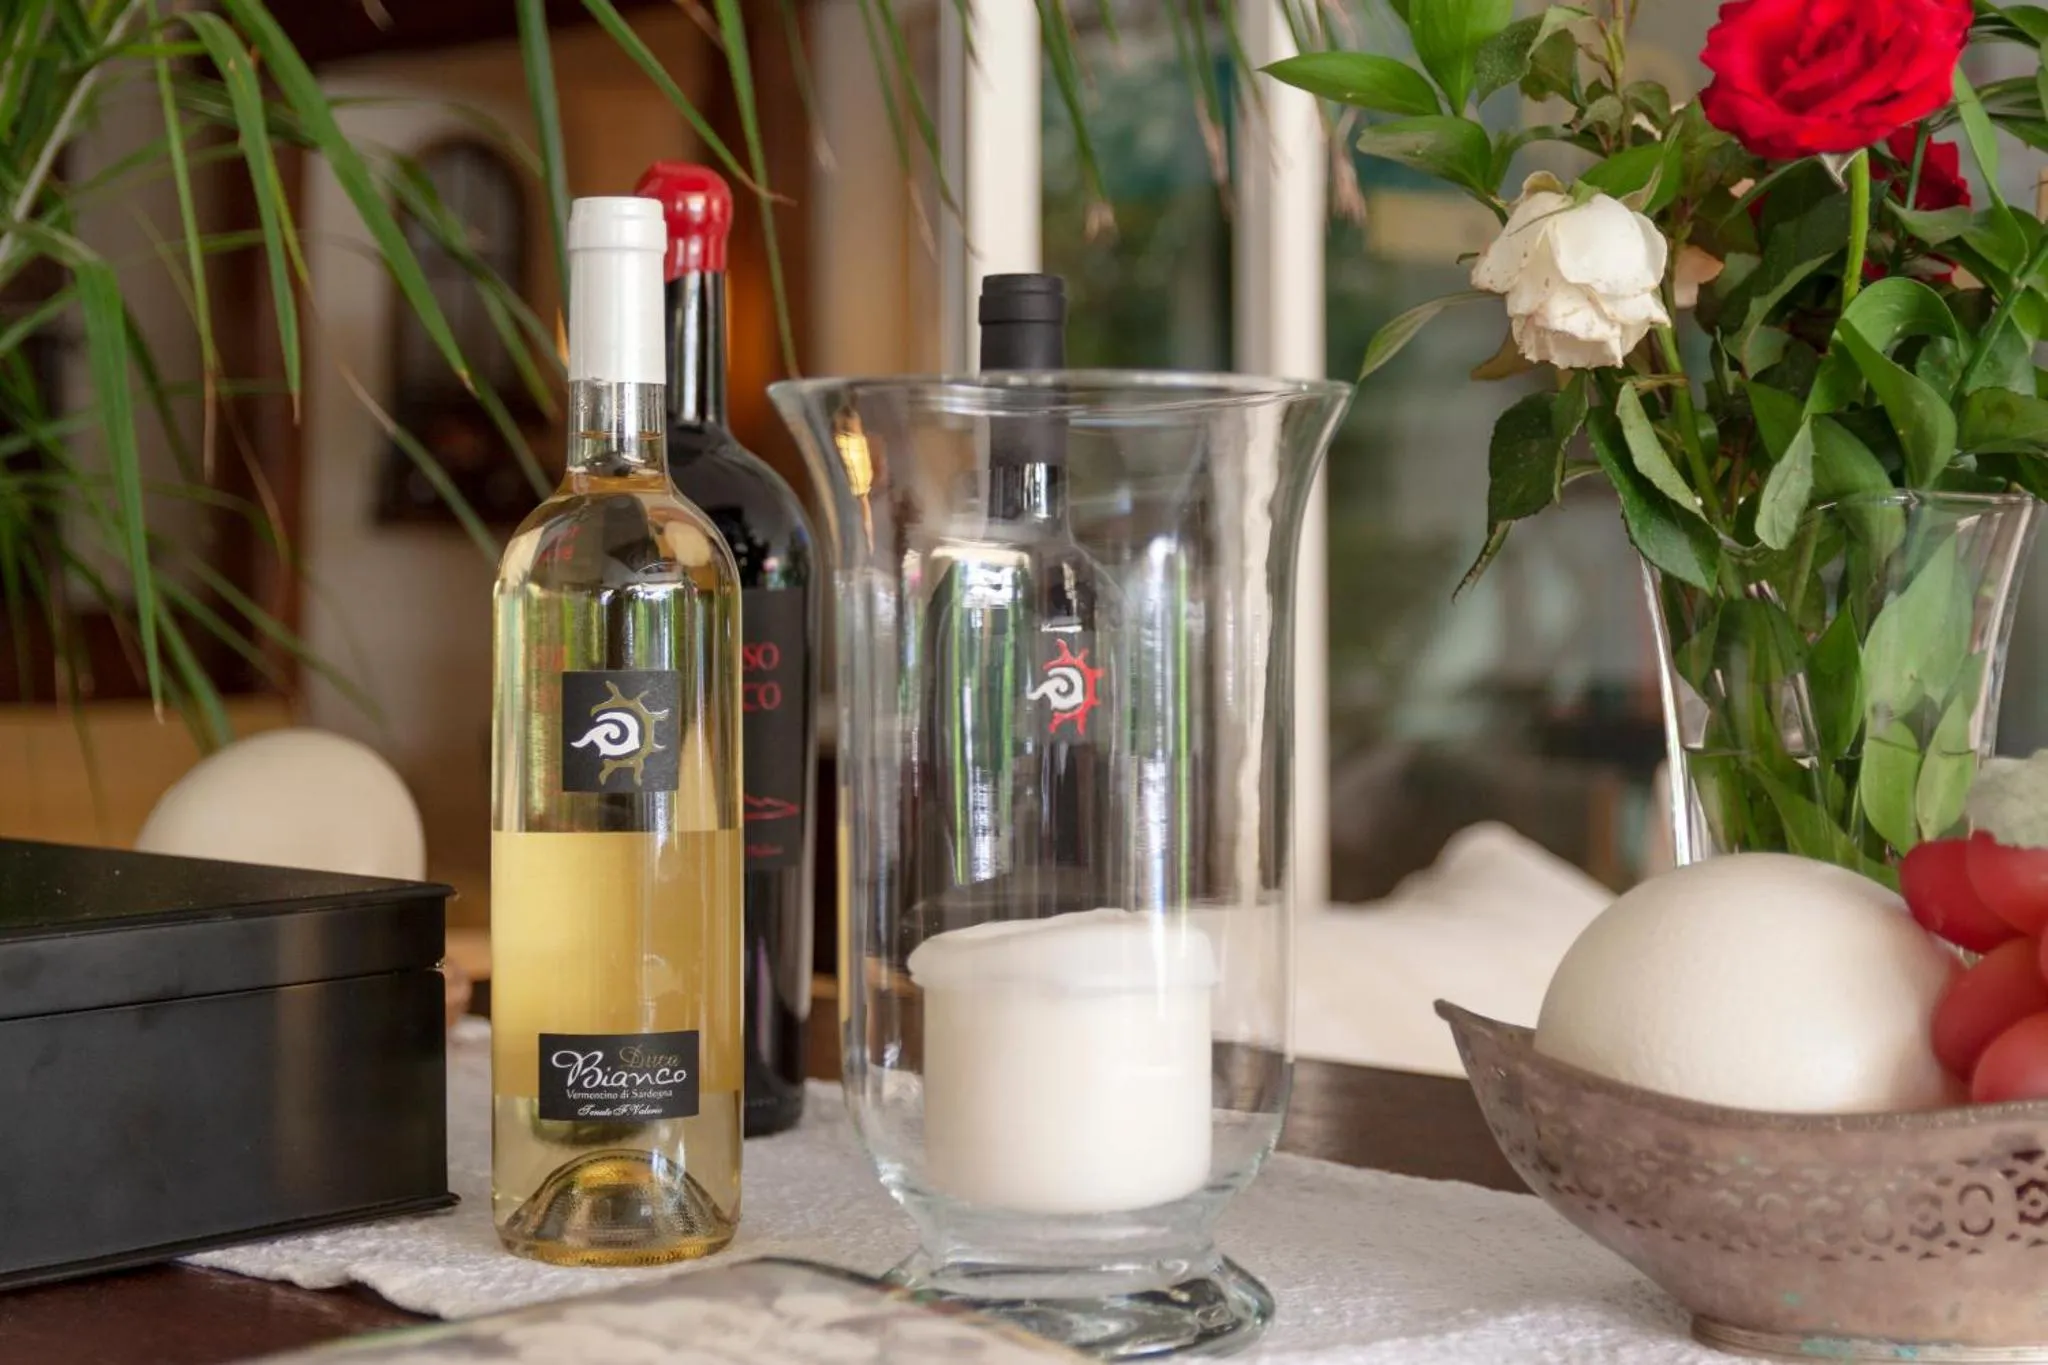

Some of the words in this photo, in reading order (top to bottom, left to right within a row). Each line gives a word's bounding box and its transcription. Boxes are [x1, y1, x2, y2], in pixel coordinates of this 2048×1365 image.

[552, 1050, 687, 1088] Bianco
[566, 1089, 618, 1099] Vermentino
[620, 1088, 629, 1099] di
[631, 1088, 673, 1099] Sardegna
